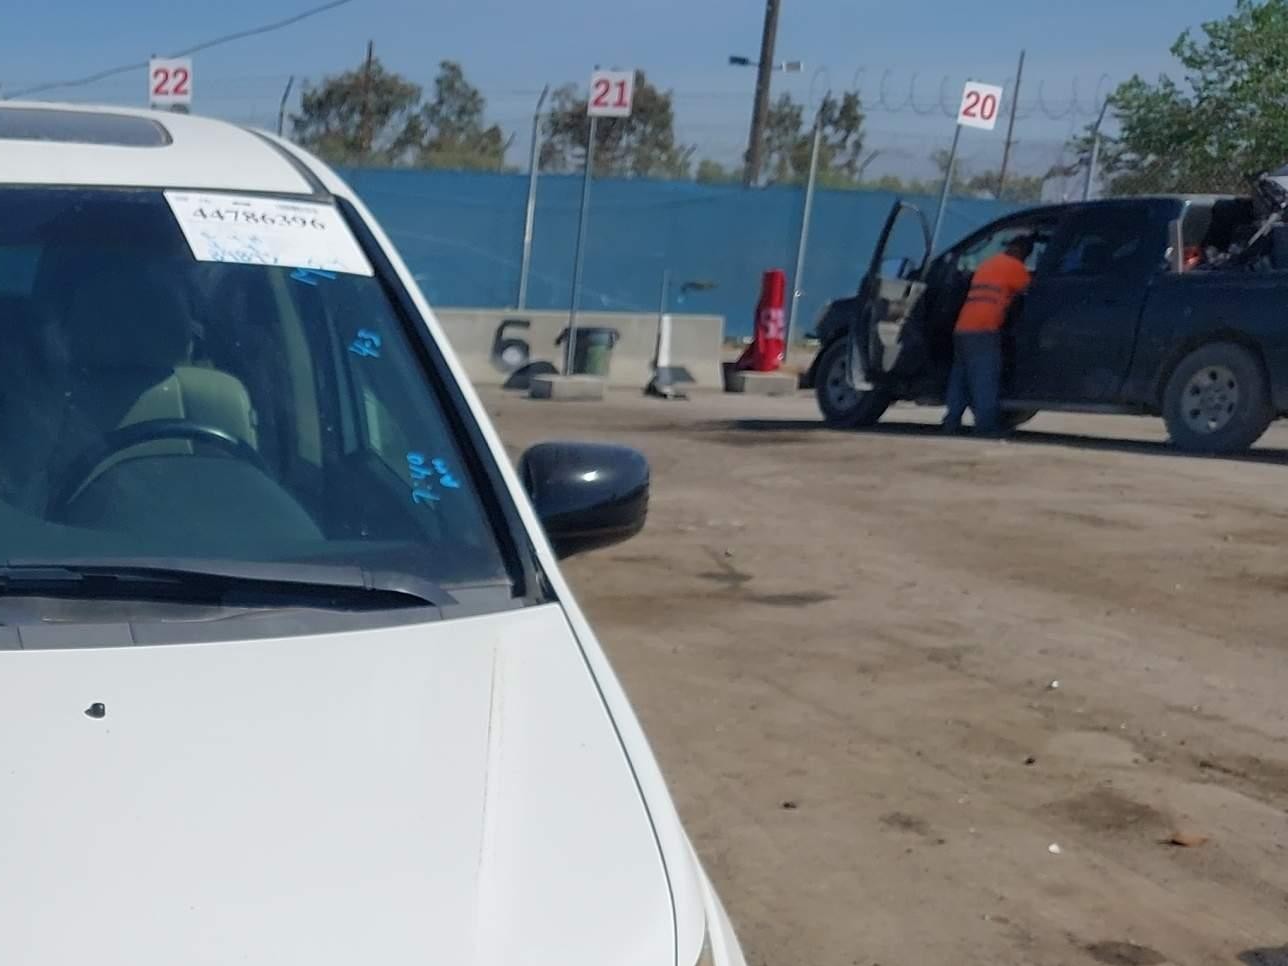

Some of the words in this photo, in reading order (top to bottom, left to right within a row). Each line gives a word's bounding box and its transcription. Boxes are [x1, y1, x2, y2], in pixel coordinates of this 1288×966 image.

[153, 67, 189, 96] 22
[593, 79, 629, 108] 21
[962, 91, 997, 121] 20
[193, 207, 326, 231] 44786396
